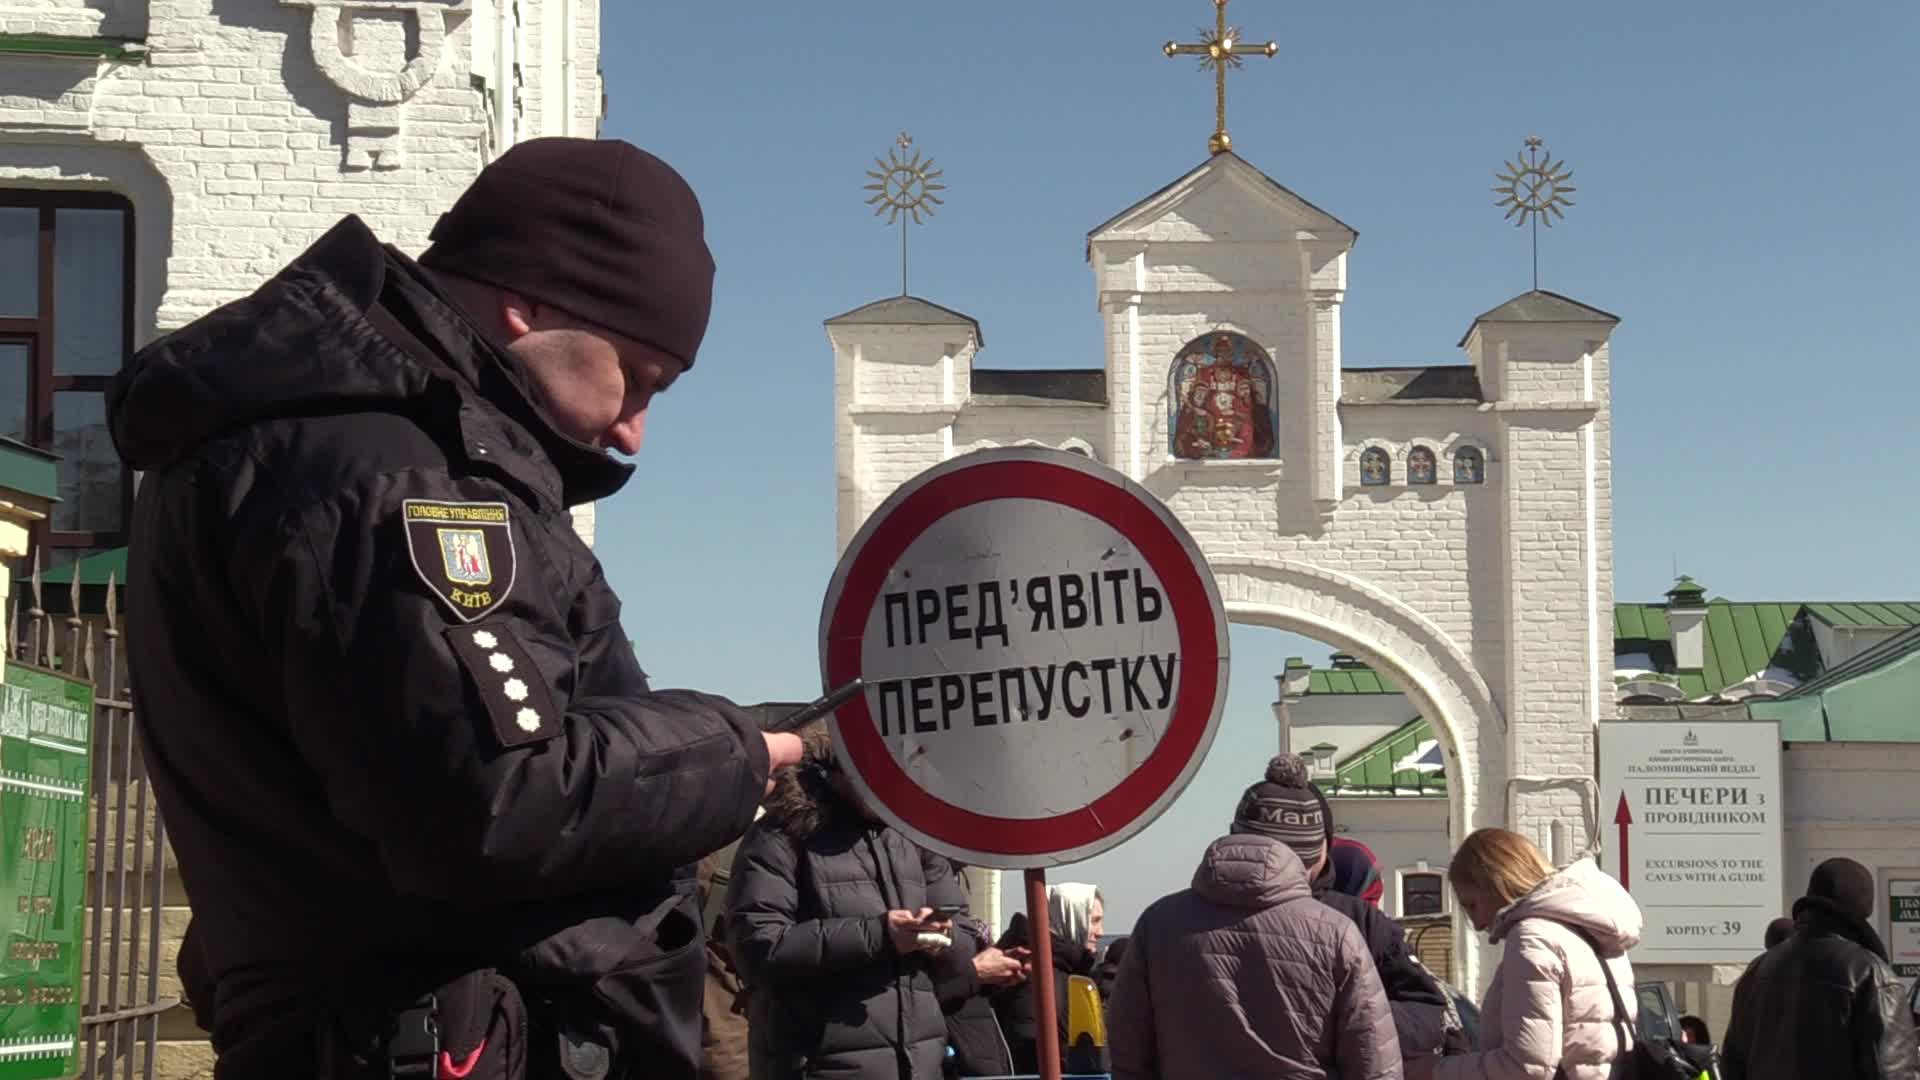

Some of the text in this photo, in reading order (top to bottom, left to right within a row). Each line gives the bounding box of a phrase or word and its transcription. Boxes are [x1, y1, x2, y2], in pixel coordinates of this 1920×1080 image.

[885, 568, 1162, 650] ПРЕД'ЯВІТЬ
[879, 652, 1177, 736] ПЕРЕПУСТКУ
[1645, 787, 1748, 806] ПЕЧЕРИ
[1645, 811, 1766, 825] ПРОВІДНИКОМ
[1646, 859, 1763, 869] EXCURSIONS TO THE
[1646, 872, 1765, 882] CAVES WITH A GUIDE
[1666, 922, 1741, 936] КОРПУС 39
